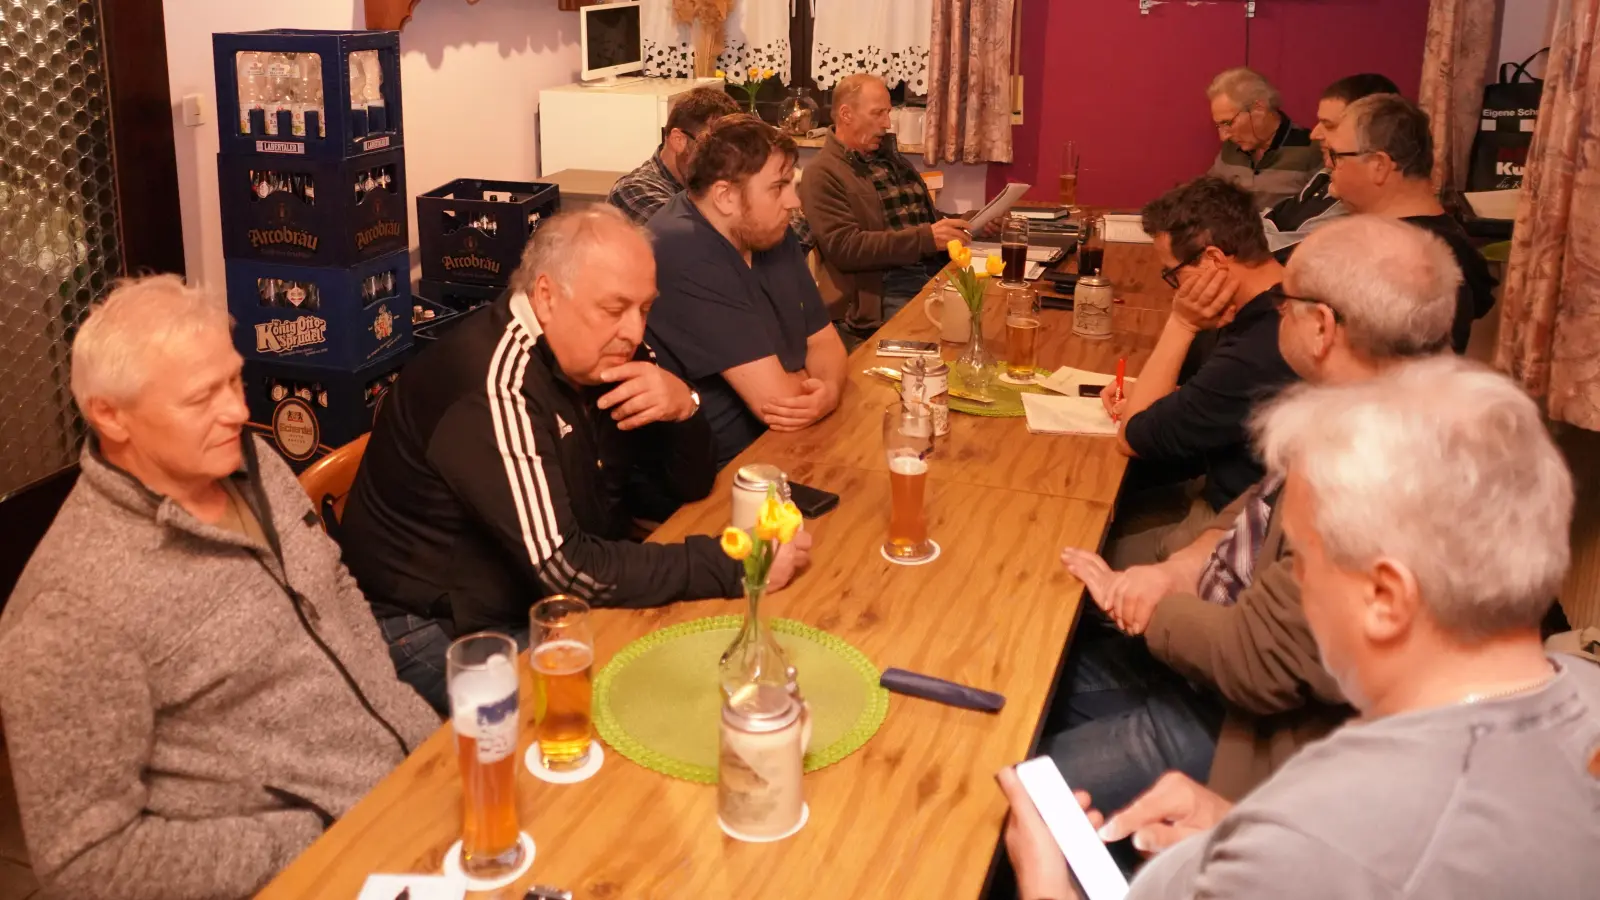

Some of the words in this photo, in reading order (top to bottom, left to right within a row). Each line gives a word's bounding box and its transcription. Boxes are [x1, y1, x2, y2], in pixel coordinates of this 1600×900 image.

[1482, 109, 1515, 118] Eigene
[1517, 108, 1539, 116] Sch
[248, 226, 319, 250] Arcobräu
[355, 220, 401, 250] Arcobräu
[442, 254, 501, 273] Arcobräu
[255, 319, 298, 351] König
[278, 328, 324, 349] Sprudel
